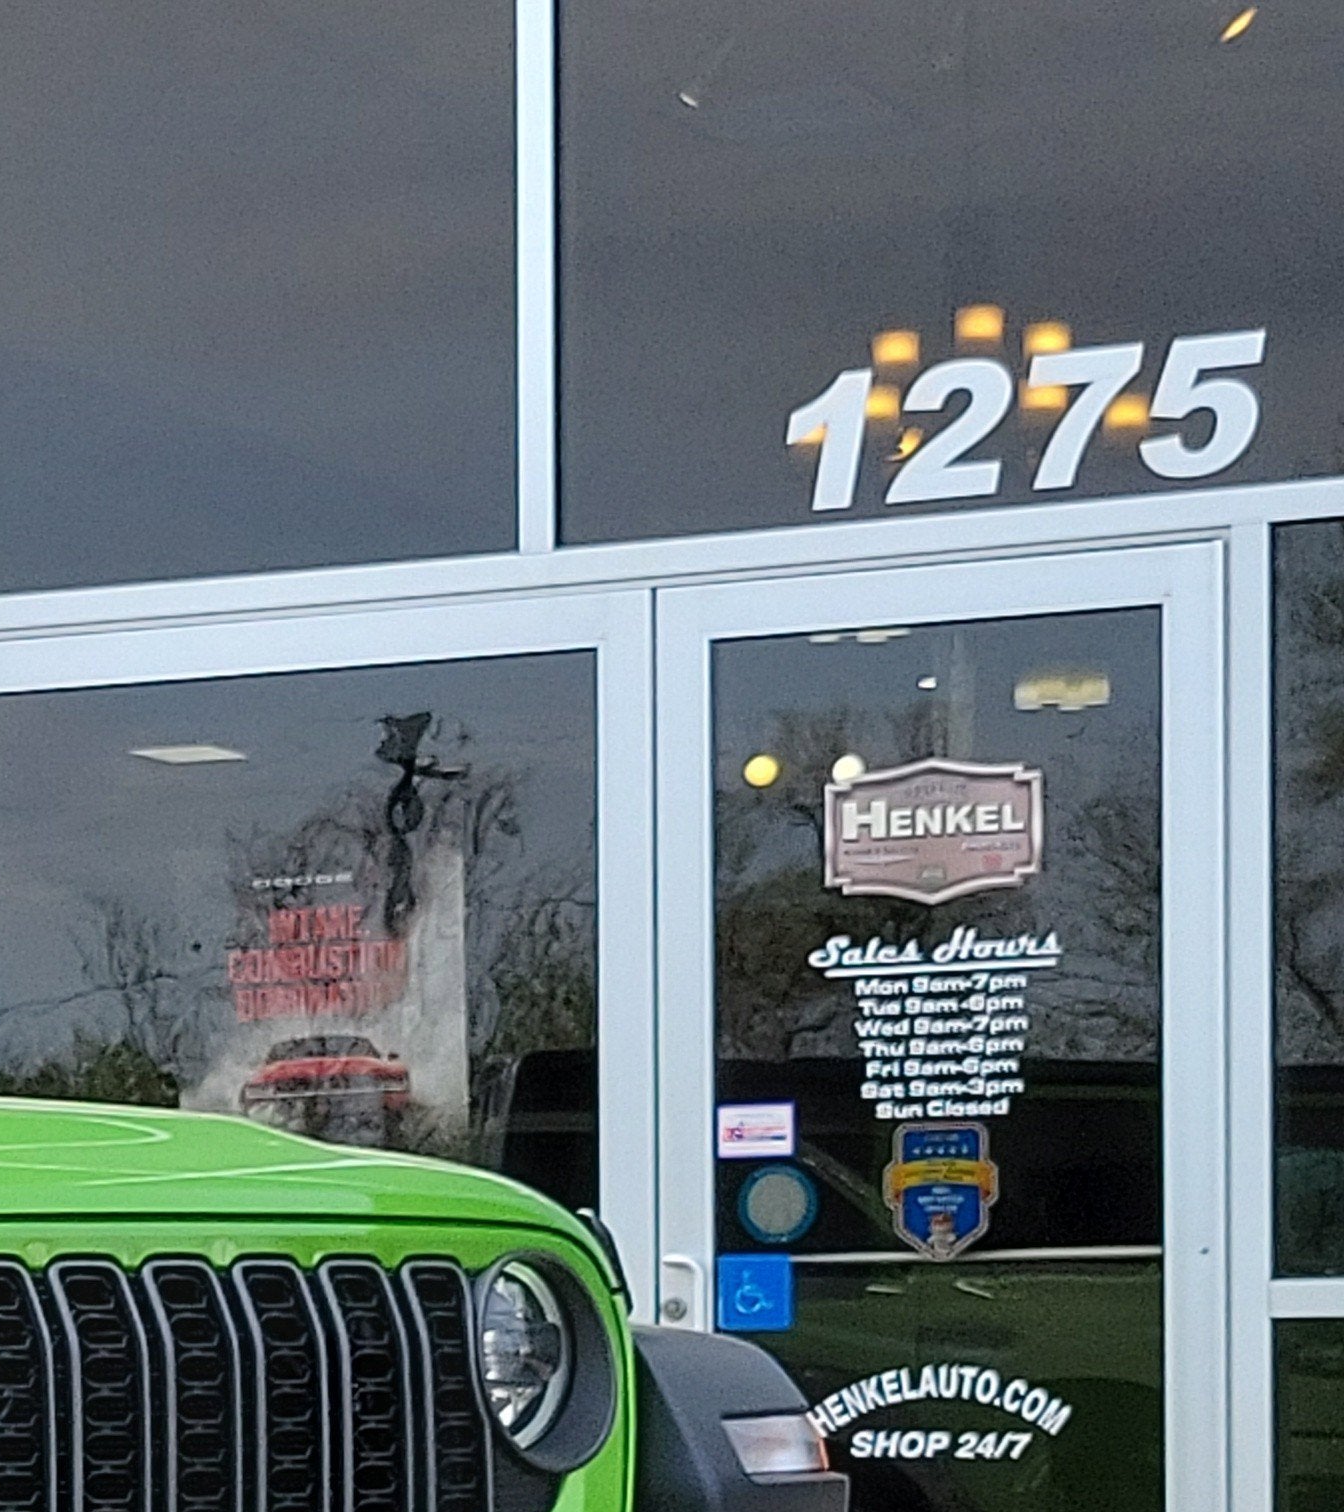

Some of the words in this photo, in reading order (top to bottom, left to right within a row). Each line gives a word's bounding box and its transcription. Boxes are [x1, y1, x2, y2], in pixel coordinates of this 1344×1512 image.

[786, 328, 1266, 512] 1275
[841, 799, 1026, 842] HENKEL
[808, 934, 923, 968] Sales
[932, 925, 1063, 964] Hours
[854, 978, 909, 997] Mon
[912, 973, 1028, 995] 9am-7pm
[858, 999, 902, 1018] Tue
[854, 1019, 910, 1038] Wed
[858, 1040, 906, 1059] Thu
[865, 1061, 901, 1079] Fri
[860, 1082, 905, 1100] Sat
[875, 1101, 924, 1120] Sun
[926, 1098, 1011, 1118] Closed
[806, 1363, 1073, 1439] HENKELAUTO.COM
[849, 1430, 952, 1460] SHOP
[953, 1431, 1034, 1461] 24/7
